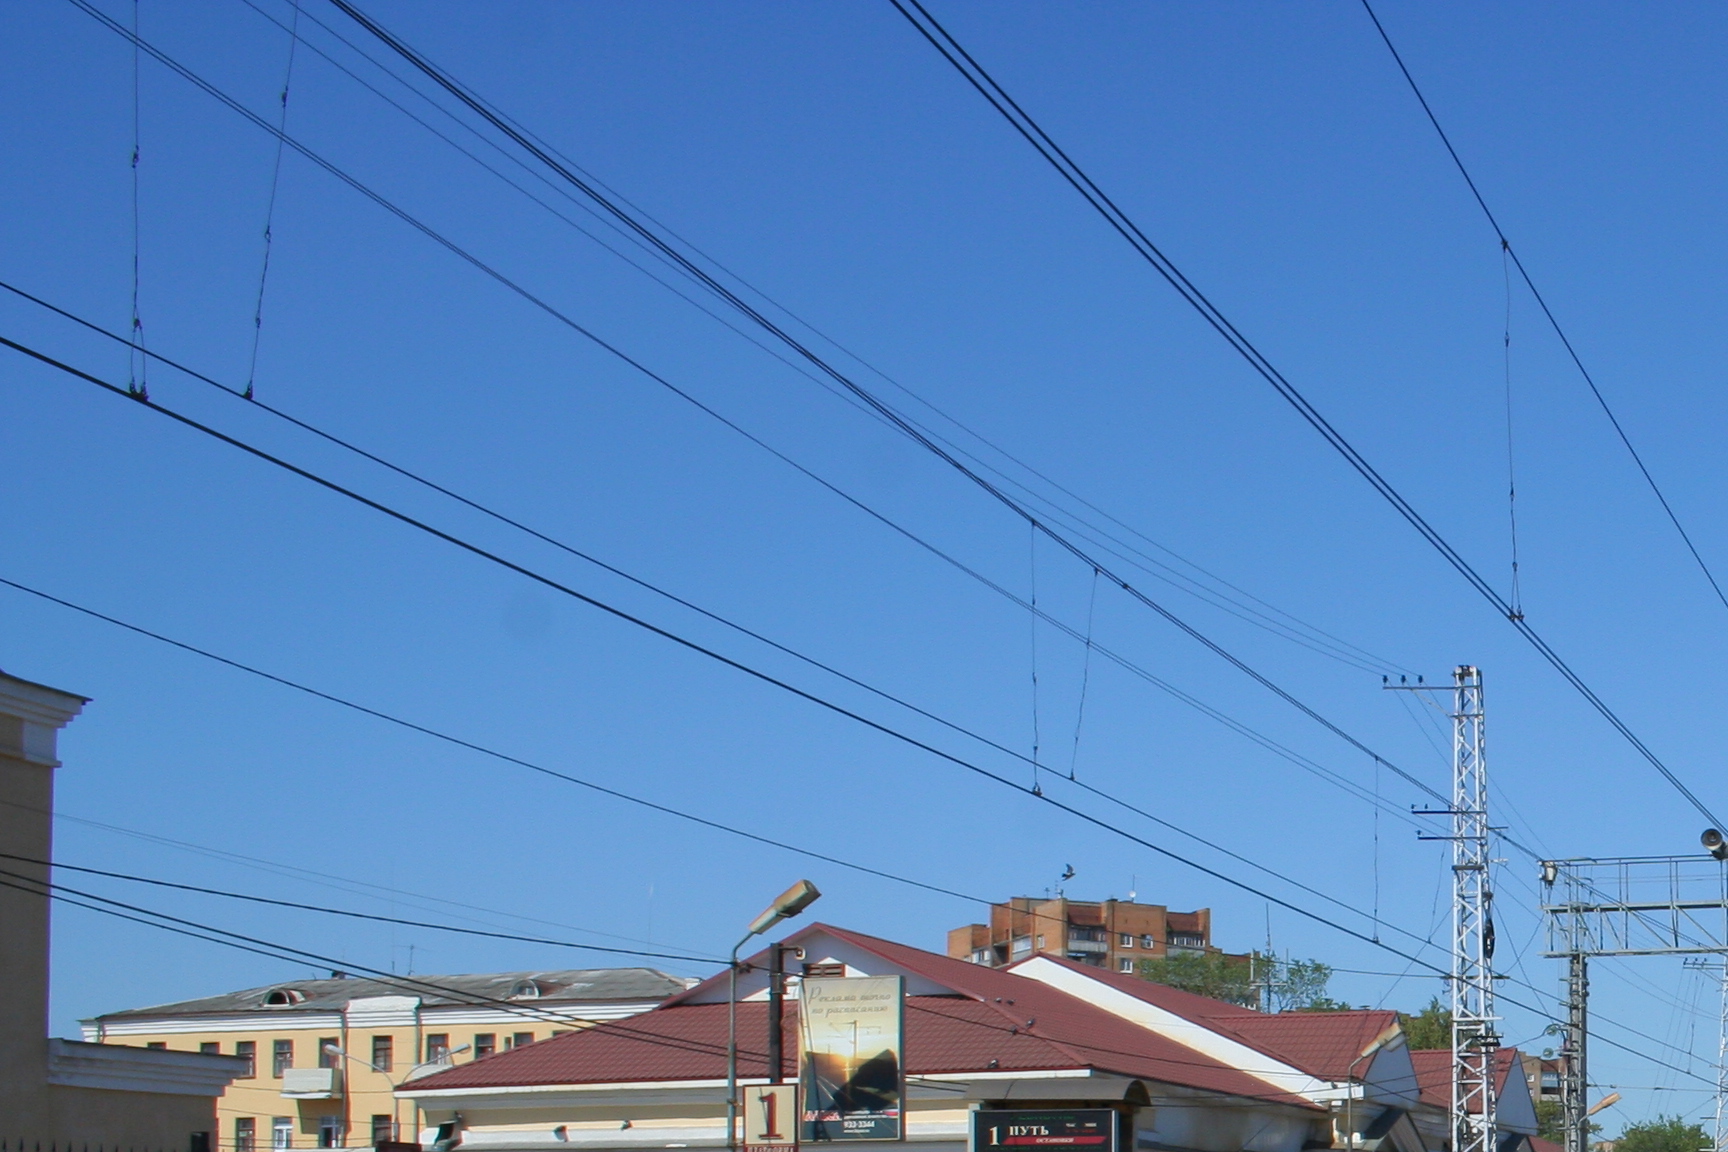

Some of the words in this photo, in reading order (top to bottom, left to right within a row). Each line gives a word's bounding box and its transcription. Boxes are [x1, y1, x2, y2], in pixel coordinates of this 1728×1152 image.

[758, 1092, 784, 1140] 1
[989, 1126, 1000, 1146] 1
[1008, 1125, 1050, 1136] ПУТЬ
